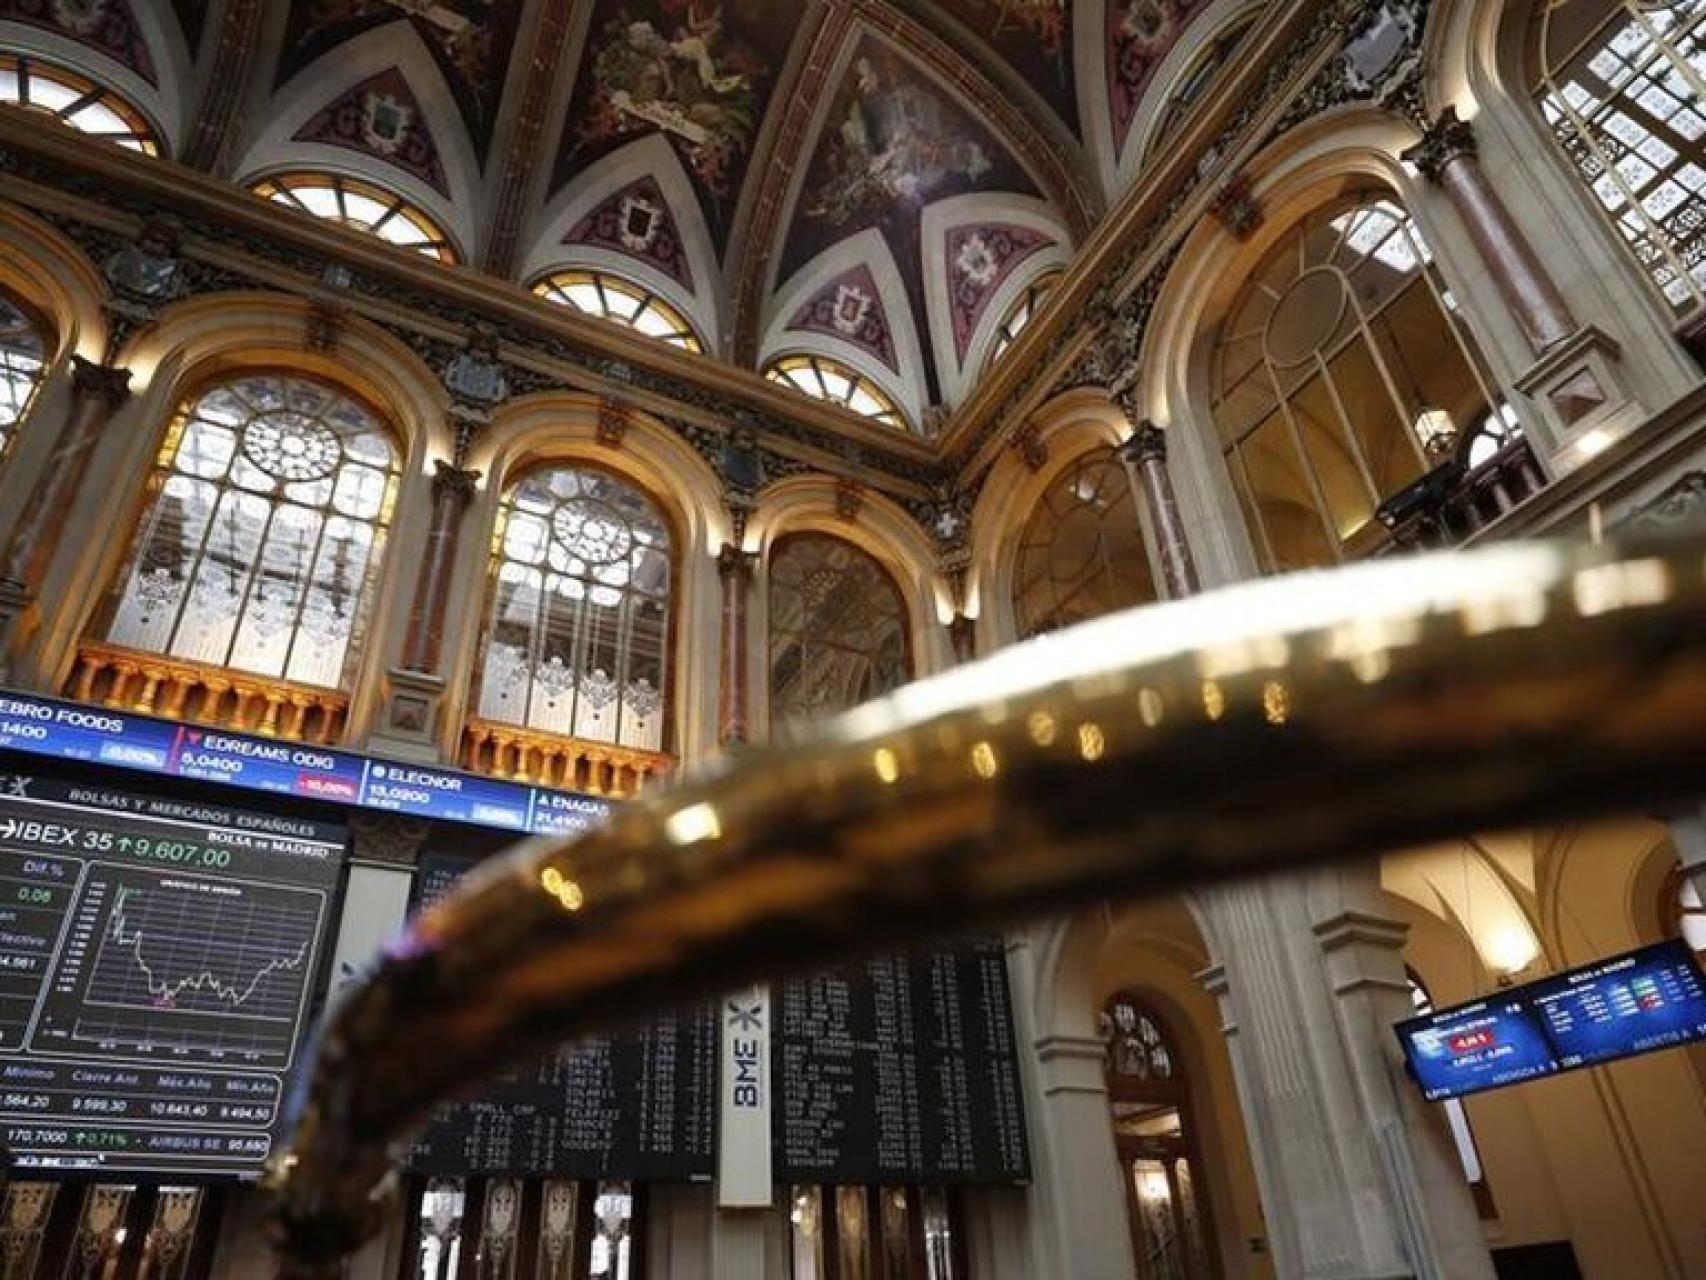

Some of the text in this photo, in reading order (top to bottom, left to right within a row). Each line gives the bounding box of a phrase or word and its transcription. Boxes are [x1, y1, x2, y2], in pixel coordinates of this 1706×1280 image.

[0, 700, 123, 732] EBRO FOODS
[204, 735, 334, 769] EDREAMS ODIG
[389, 768, 462, 791] ELECNOR
[69, 788, 315, 836] BOLSAS Y MERCADOS ESPAÑOLES
[15, 820, 231, 867] IBEX 35 9.607,00
[734, 1038, 758, 1107] BME
